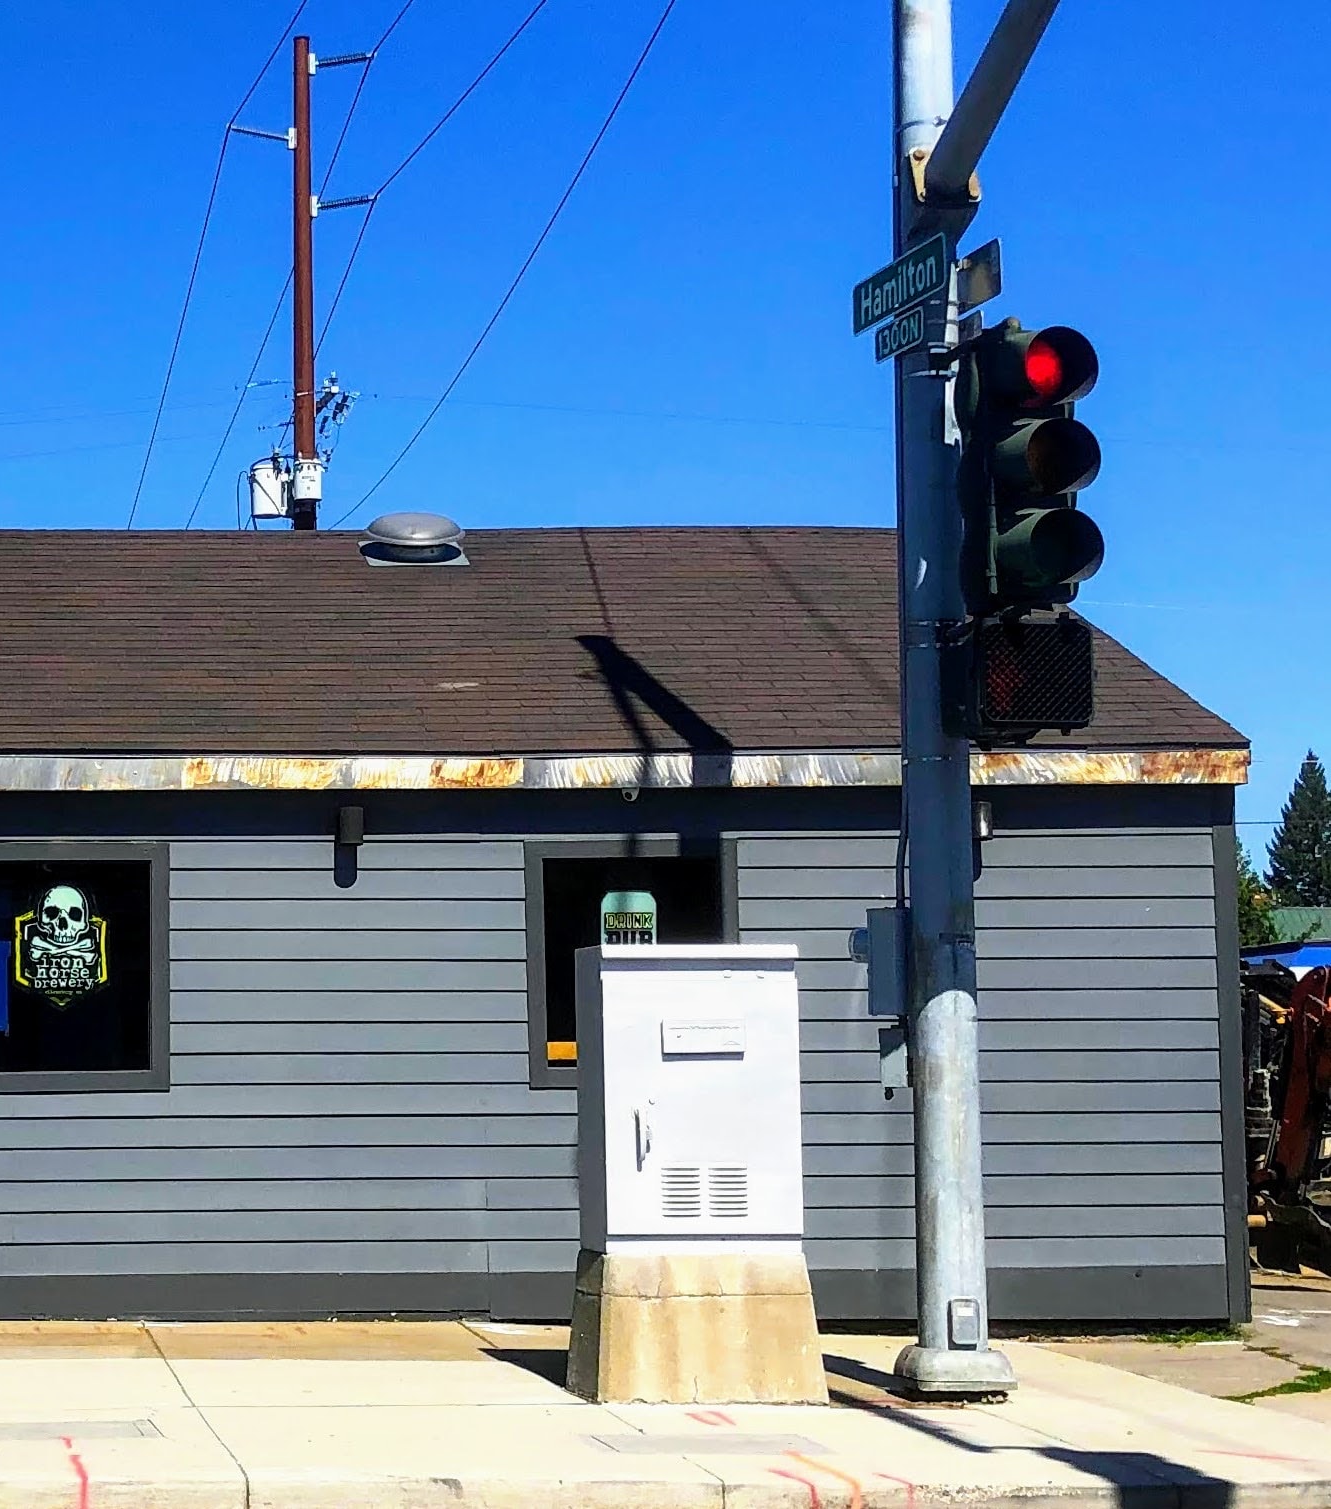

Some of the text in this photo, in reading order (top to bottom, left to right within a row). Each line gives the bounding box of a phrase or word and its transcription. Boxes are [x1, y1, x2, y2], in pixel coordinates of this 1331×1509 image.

[861, 255, 936, 325] Hamilton
[605, 913, 653, 929] DRINK
[41, 955, 84, 968] iron
[36, 965, 90, 979] horse
[34, 978, 94, 990] brewery
